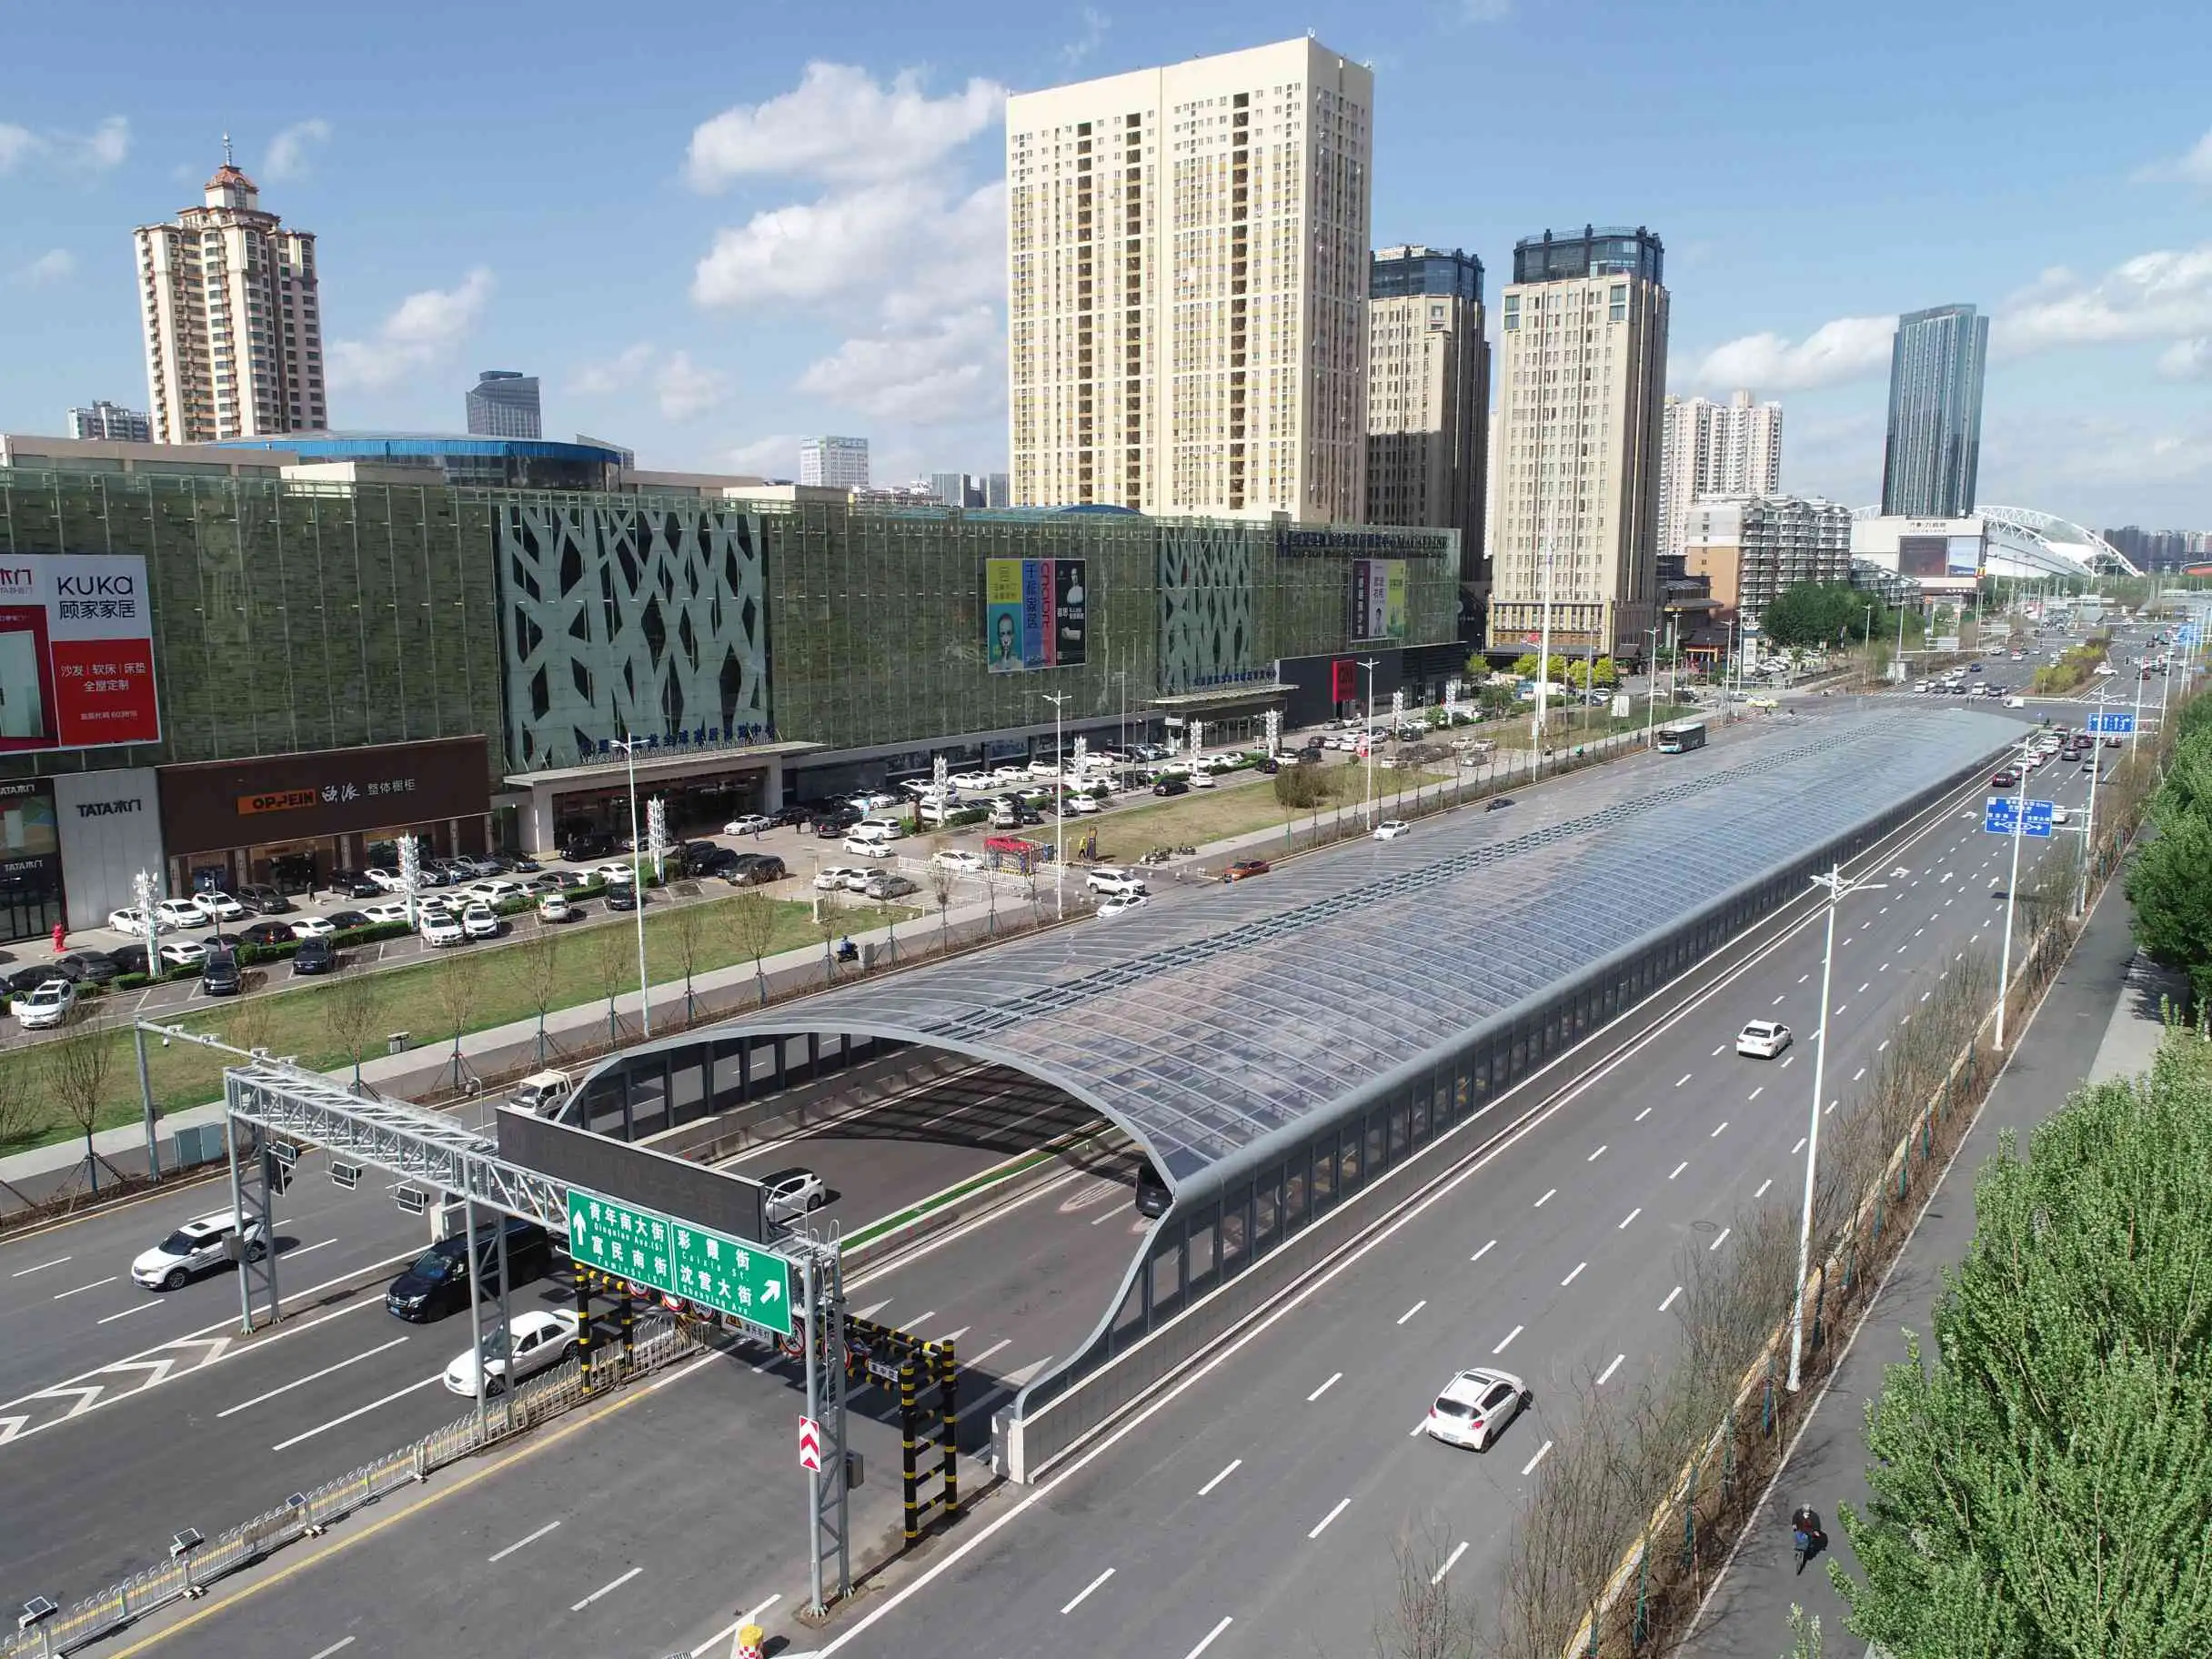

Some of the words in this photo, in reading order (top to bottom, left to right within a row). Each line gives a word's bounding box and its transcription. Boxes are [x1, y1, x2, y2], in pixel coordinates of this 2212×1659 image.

[59, 599, 136, 620] 顾家家居
[84, 679, 129, 692] 全屋定制
[321, 782, 361, 804] 欧派
[367, 779, 416, 796] 整体橱柜
[76, 799, 142, 818] TATA木门
[4, 859, 44, 873] TATA木门
[589, 1202, 664, 1242] 青年南大街
[591, 1234, 668, 1277] 富民南街
[678, 1229, 749, 1271] 彩霞街
[680, 1263, 751, 1307] 沈营大街
